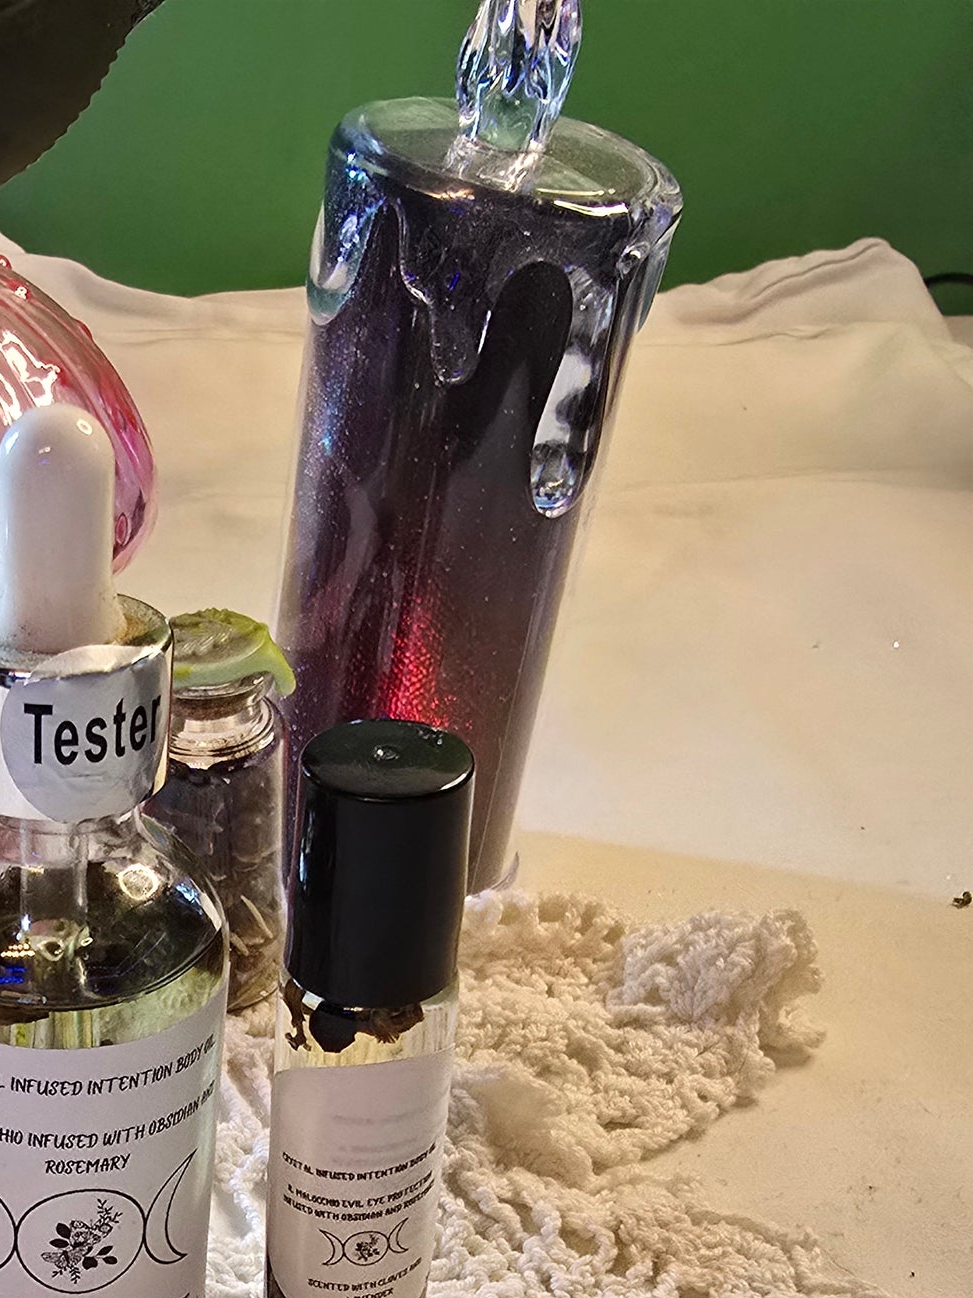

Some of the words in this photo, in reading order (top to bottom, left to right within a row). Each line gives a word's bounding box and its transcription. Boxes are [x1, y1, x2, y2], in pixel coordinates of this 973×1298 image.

[24, 695, 162, 766] Tester
[11, 1076, 83, 1096] INFUSED
[87, 1062, 173, 1095] INTENTION
[175, 1043, 204, 1074] BODY
[27, 1132, 98, 1149] INFUSED
[103, 1124, 145, 1146] WITH
[148, 1096, 200, 1136] OBSIDIAN
[45, 1153, 131, 1174] ROSEMARY
[342, 1199, 364, 1208] EVIL
[367, 1196, 385, 1207] EYE
[385, 1204, 402, 1216] AND
